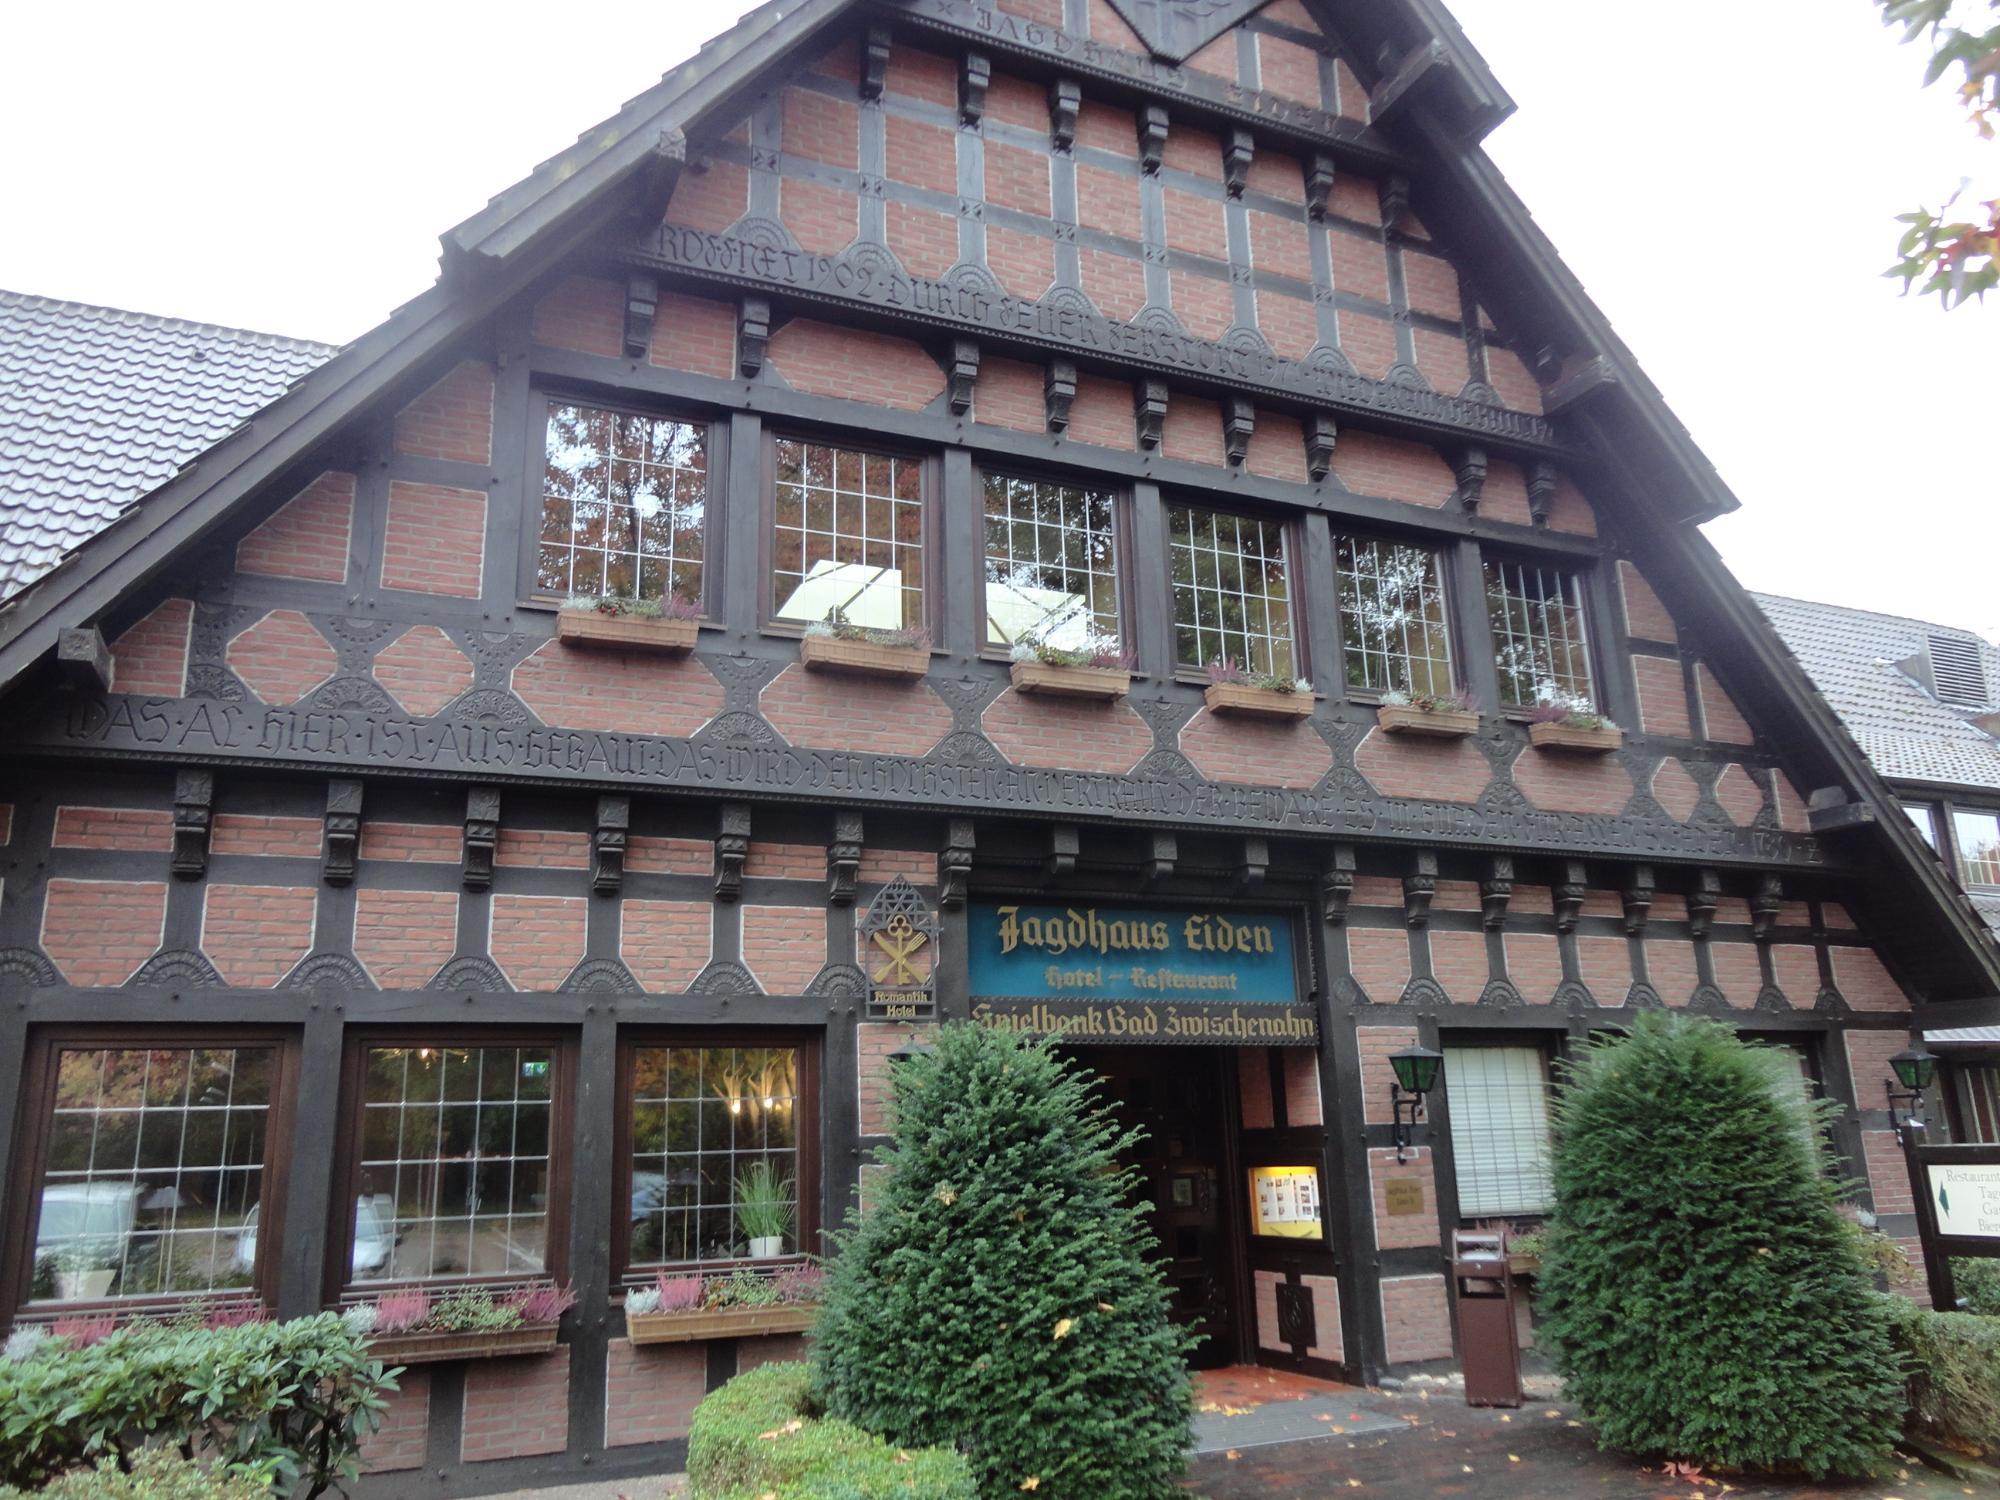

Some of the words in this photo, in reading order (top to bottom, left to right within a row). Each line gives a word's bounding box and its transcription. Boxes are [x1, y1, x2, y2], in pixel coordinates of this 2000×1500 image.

[807, 255, 873, 299] 1902
[431, 722, 516, 768] AUS
[997, 905, 1170, 955] Jagdhaus
[1184, 913, 1274, 953] Eiden
[873, 989, 928, 1003] Romantik
[1044, 965, 1102, 989] Hotel
[886, 1004, 916, 1017] Hotel
[971, 1002, 1105, 1036] Spielbank
[1106, 1004, 1158, 1036] Bad
[1164, 1006, 1314, 1040] Zwischenahn
